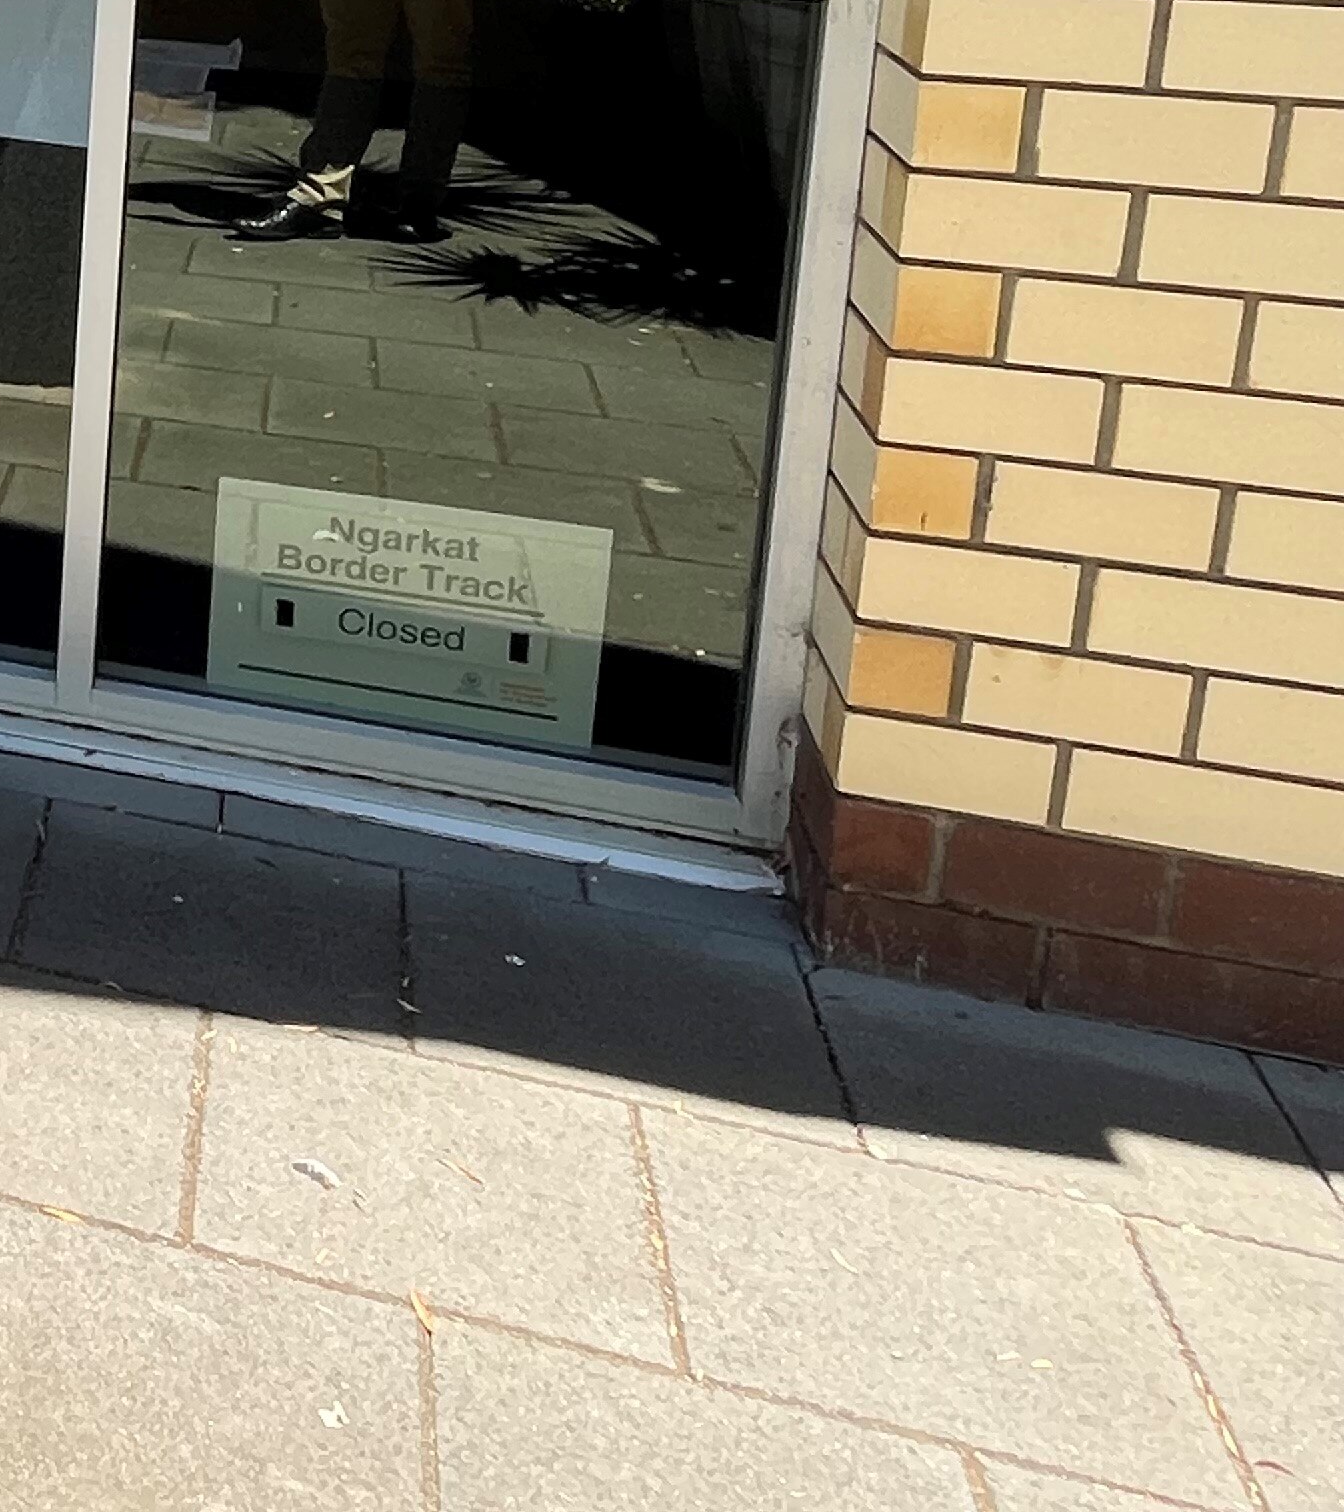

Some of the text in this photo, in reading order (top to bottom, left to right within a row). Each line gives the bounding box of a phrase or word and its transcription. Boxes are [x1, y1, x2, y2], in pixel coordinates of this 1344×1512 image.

[329, 516, 480, 562] Ngarkat
[277, 543, 530, 605] Border Track
[338, 607, 467, 652] Closed
